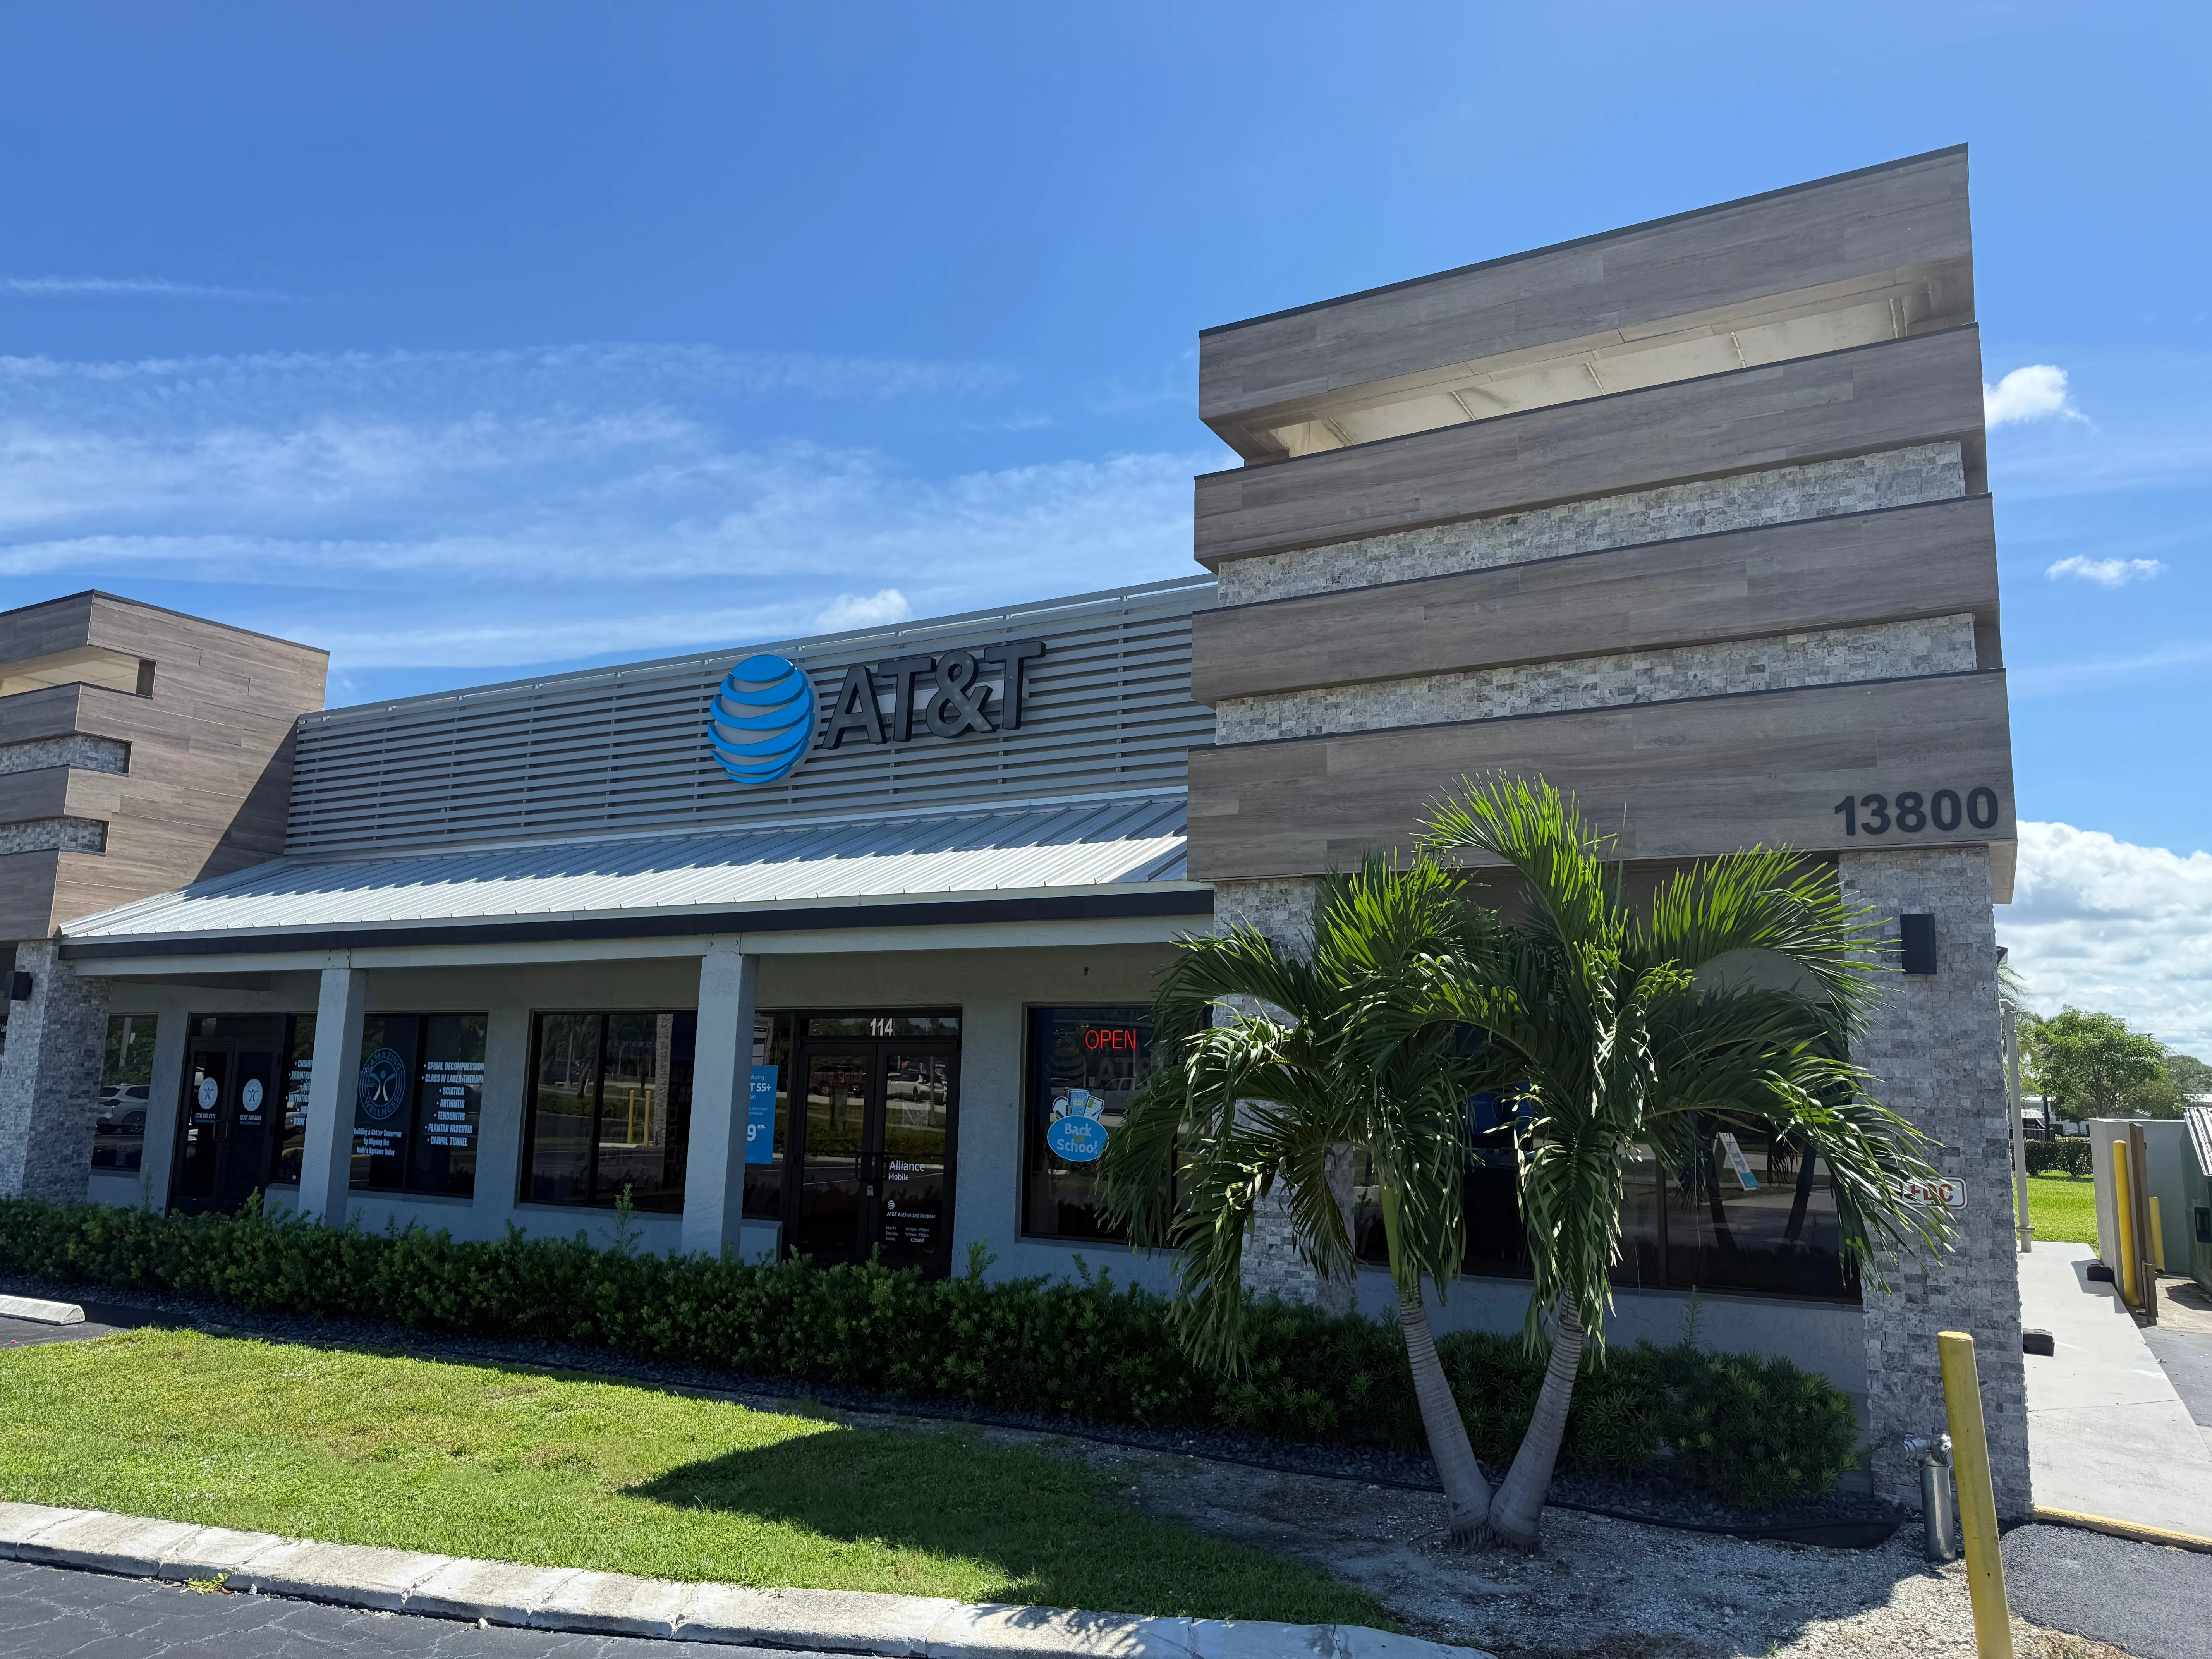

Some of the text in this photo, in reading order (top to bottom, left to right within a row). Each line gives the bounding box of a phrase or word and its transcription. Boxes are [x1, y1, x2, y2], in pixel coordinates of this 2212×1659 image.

[823, 641, 1046, 750] AT&T
[1834, 787, 1998, 835] 13800
[870, 1018, 893, 1036] 114
[1085, 1030, 1137, 1050] OPEN
[369, 1051, 402, 1071] AMAZING
[427, 1061, 484, 1071] SPINAL DECOMPRESSION
[425, 1074, 440, 1083] CLASS
[441, 1074, 446, 1083] IV
[447, 1074, 462, 1083] LASER
[443, 1086, 464, 1096] SCIATICA
[756, 1082, 771, 1092] 55+
[364, 1096, 400, 1117] WELLNESS
[440, 1099, 465, 1108] ARTHRITIS
[437, 1111, 465, 1121] TENDONITIS
[428, 1123, 449, 1133] PLANTAR
[747, 1124, 757, 1141] 9
[1064, 1123, 1092, 1137] Back
[430, 1136, 468, 1146] CARPAL TUNNEL
[1056, 1139, 1099, 1154] School
[889, 1160, 925, 1172] Alliance
[888, 1173, 909, 1181] Mobile
